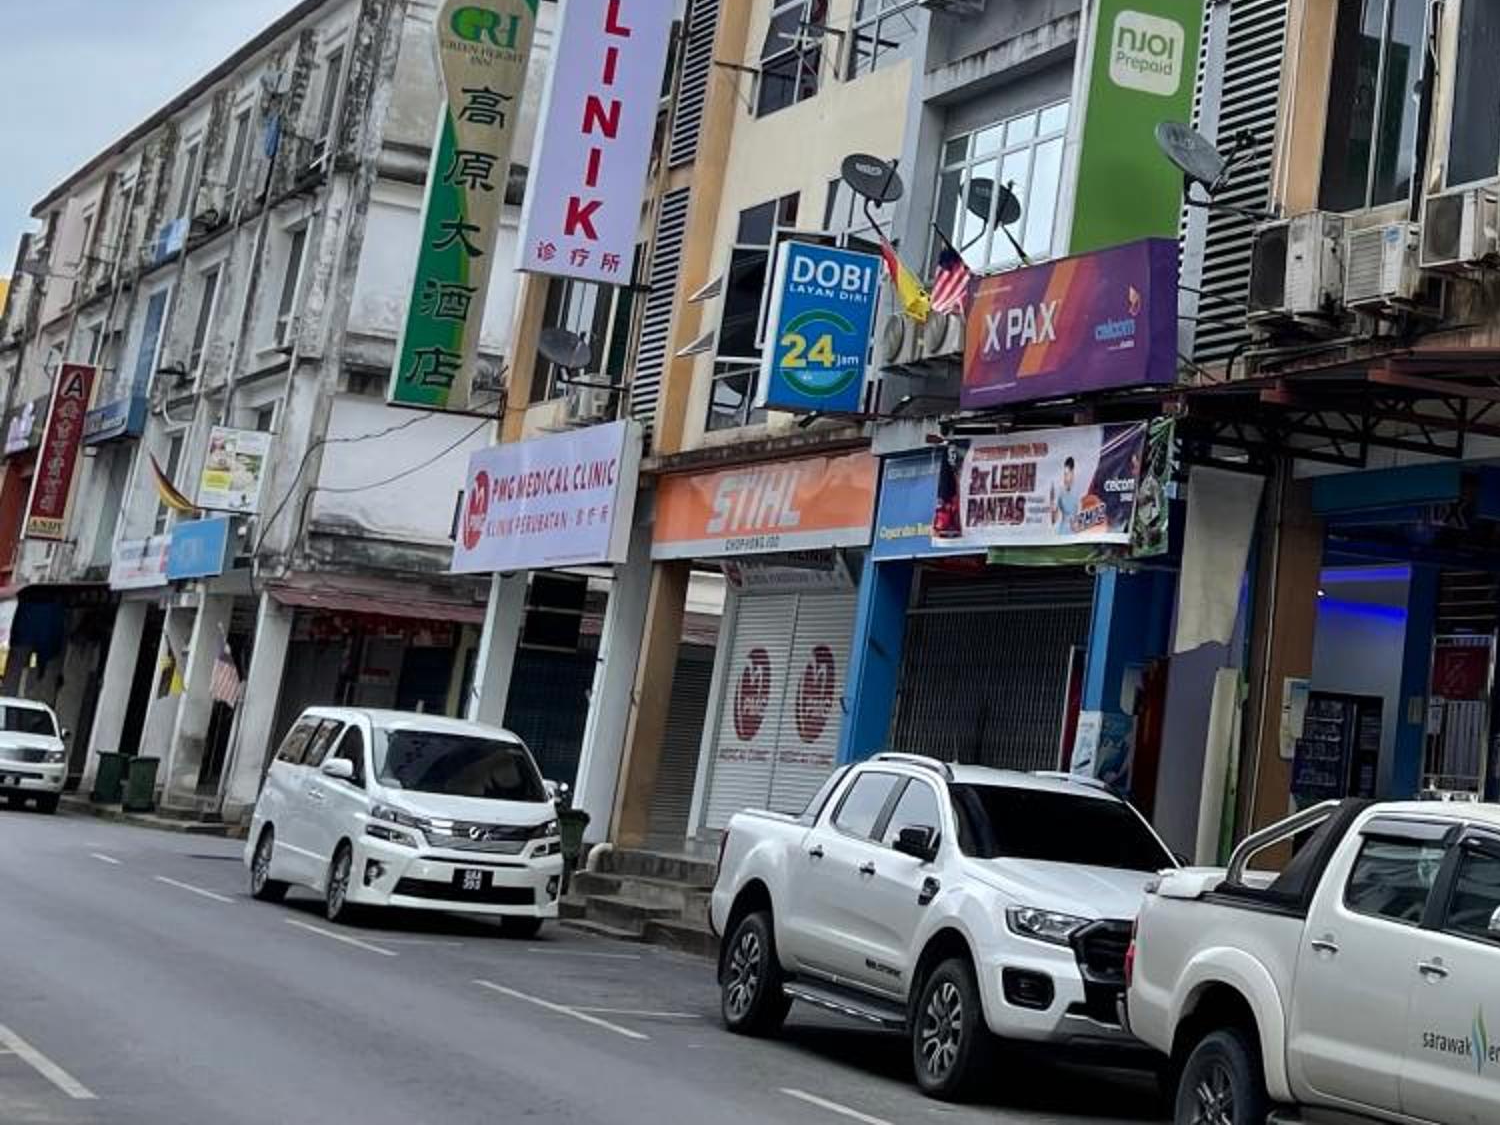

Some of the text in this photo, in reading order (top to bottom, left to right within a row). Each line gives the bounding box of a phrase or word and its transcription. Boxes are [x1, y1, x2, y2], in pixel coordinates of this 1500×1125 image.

[1115, 51, 1173, 75] Prepaid
[406, 86, 513, 390] 高原大酒店
[536, 241, 622, 274] 诊疗所
[791, 255, 872, 294] DOBI
[789, 283, 868, 303] LAYAN DIRI
[780, 333, 860, 368] 24 jam
[491, 458, 617, 502] PMG MEDICAL CLINIC
[990, 462, 1037, 492] LEBIH
[705, 468, 801, 533] STIHL
[966, 495, 1026, 527] PANTAS
[1422, 1030, 1473, 1057] sarawak
